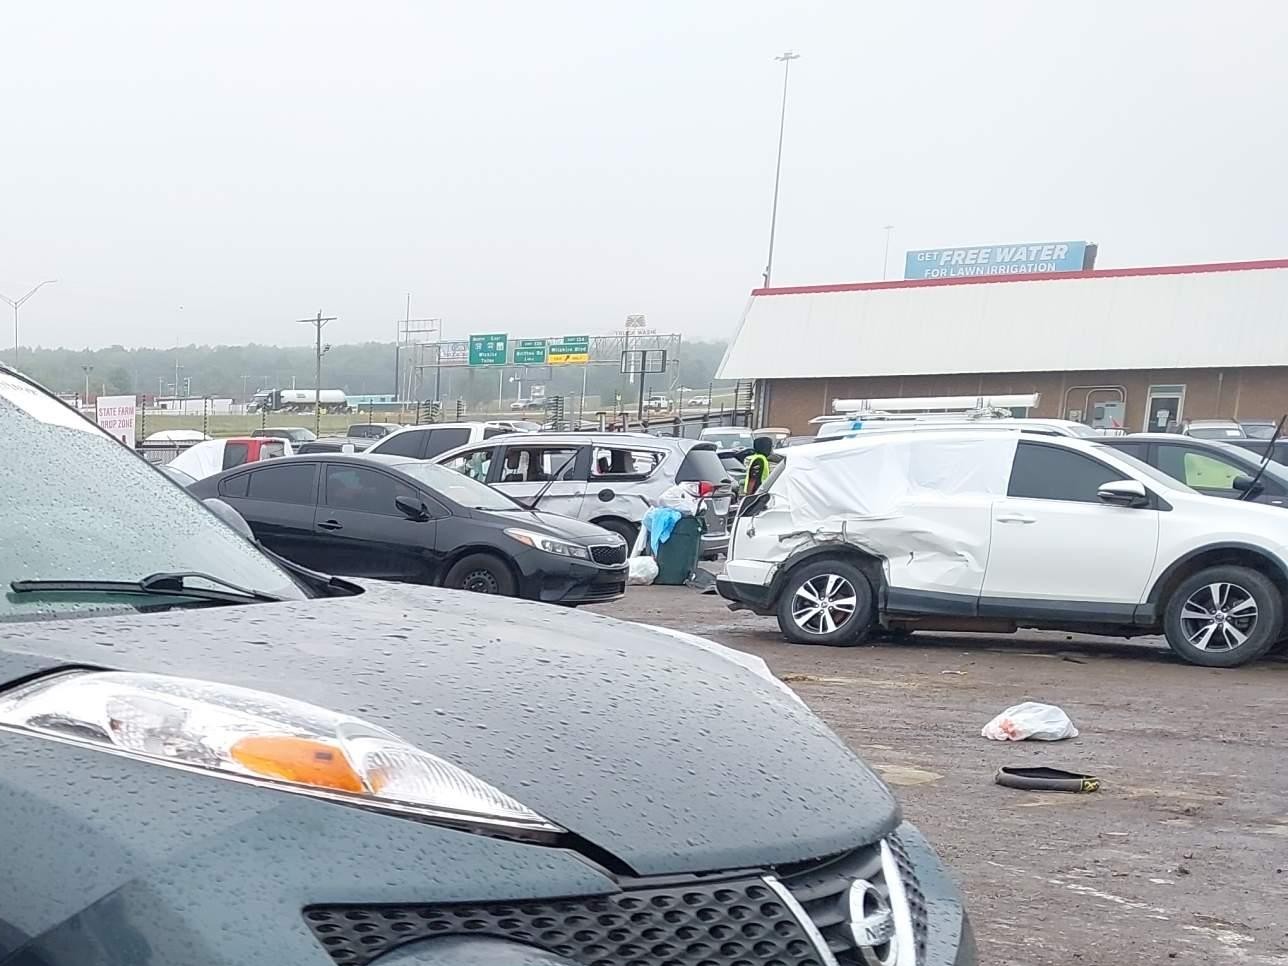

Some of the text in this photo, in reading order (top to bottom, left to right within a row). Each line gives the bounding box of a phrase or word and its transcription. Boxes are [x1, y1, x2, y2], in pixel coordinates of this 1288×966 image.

[917, 244, 1068, 266] GET FREE WATER
[923, 262, 1056, 278] FOR LAWN IRRIGATION
[98, 406, 134, 417] STATE FARM
[117, 418, 133, 428] ZONE
